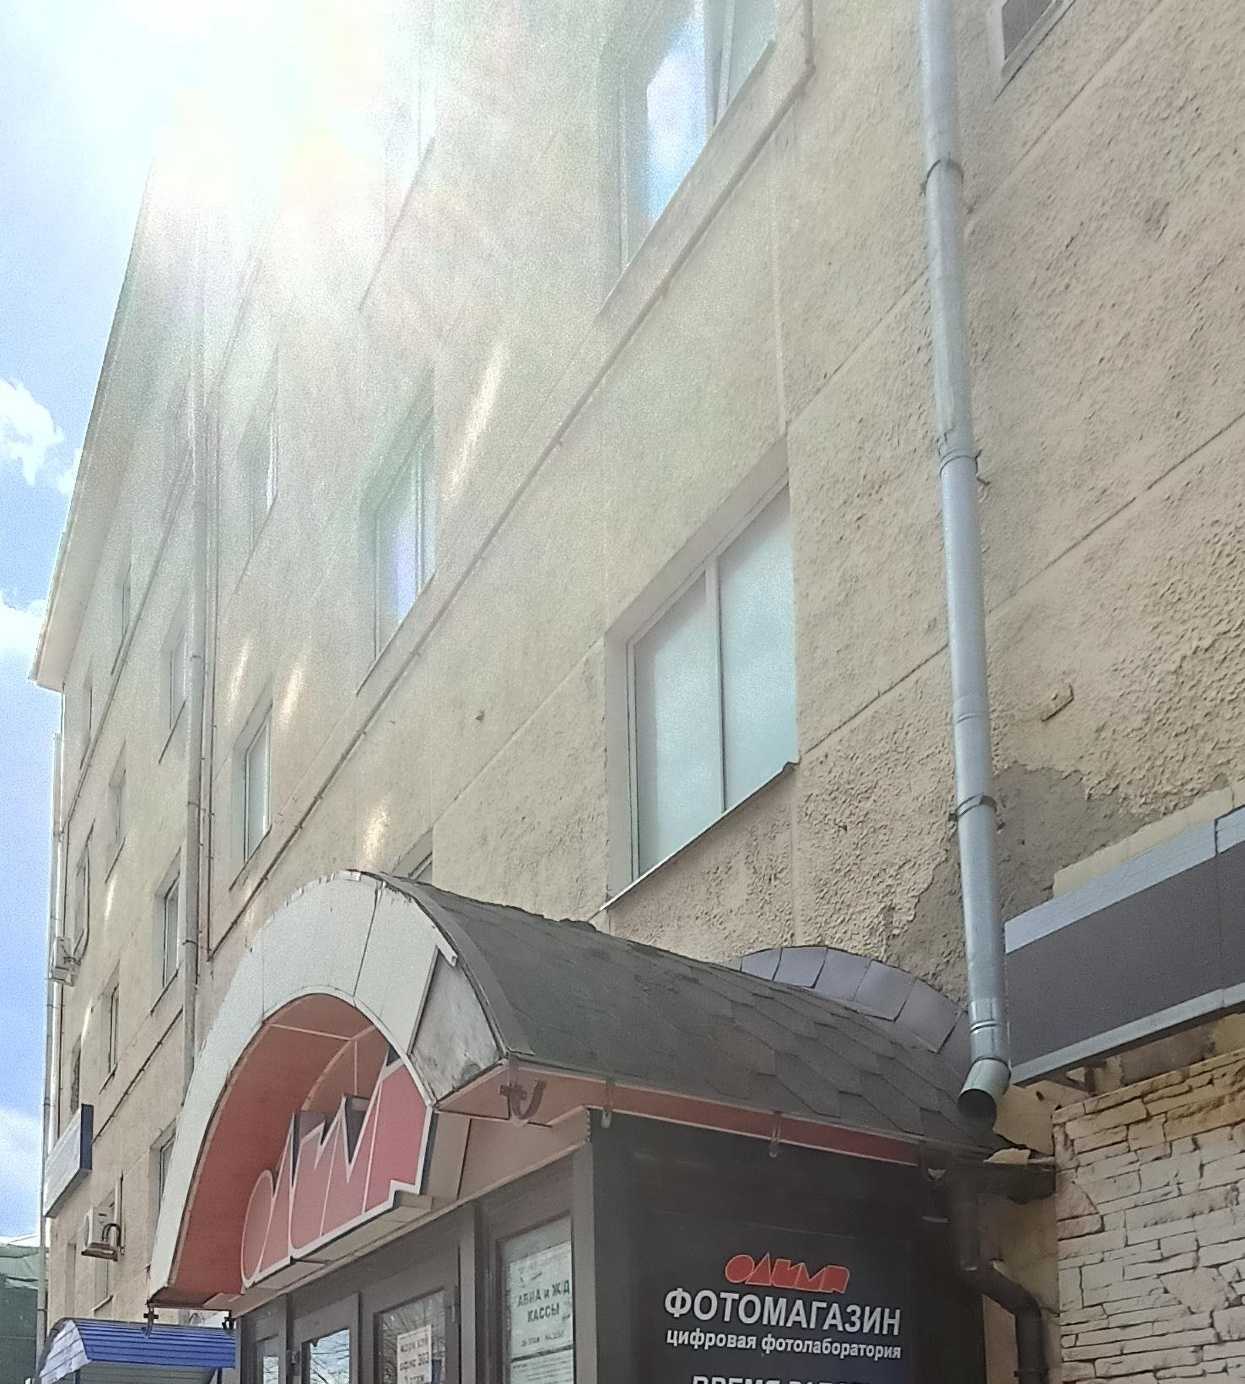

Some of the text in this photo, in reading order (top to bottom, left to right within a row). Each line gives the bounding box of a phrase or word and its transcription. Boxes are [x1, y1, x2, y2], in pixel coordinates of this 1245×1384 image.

[528, 1302, 560, 1322] КАССЫ
[664, 1288, 901, 1336] ФОТОМАГАЗИН
[666, 1328, 901, 1360] цифровая фотолаборатория
